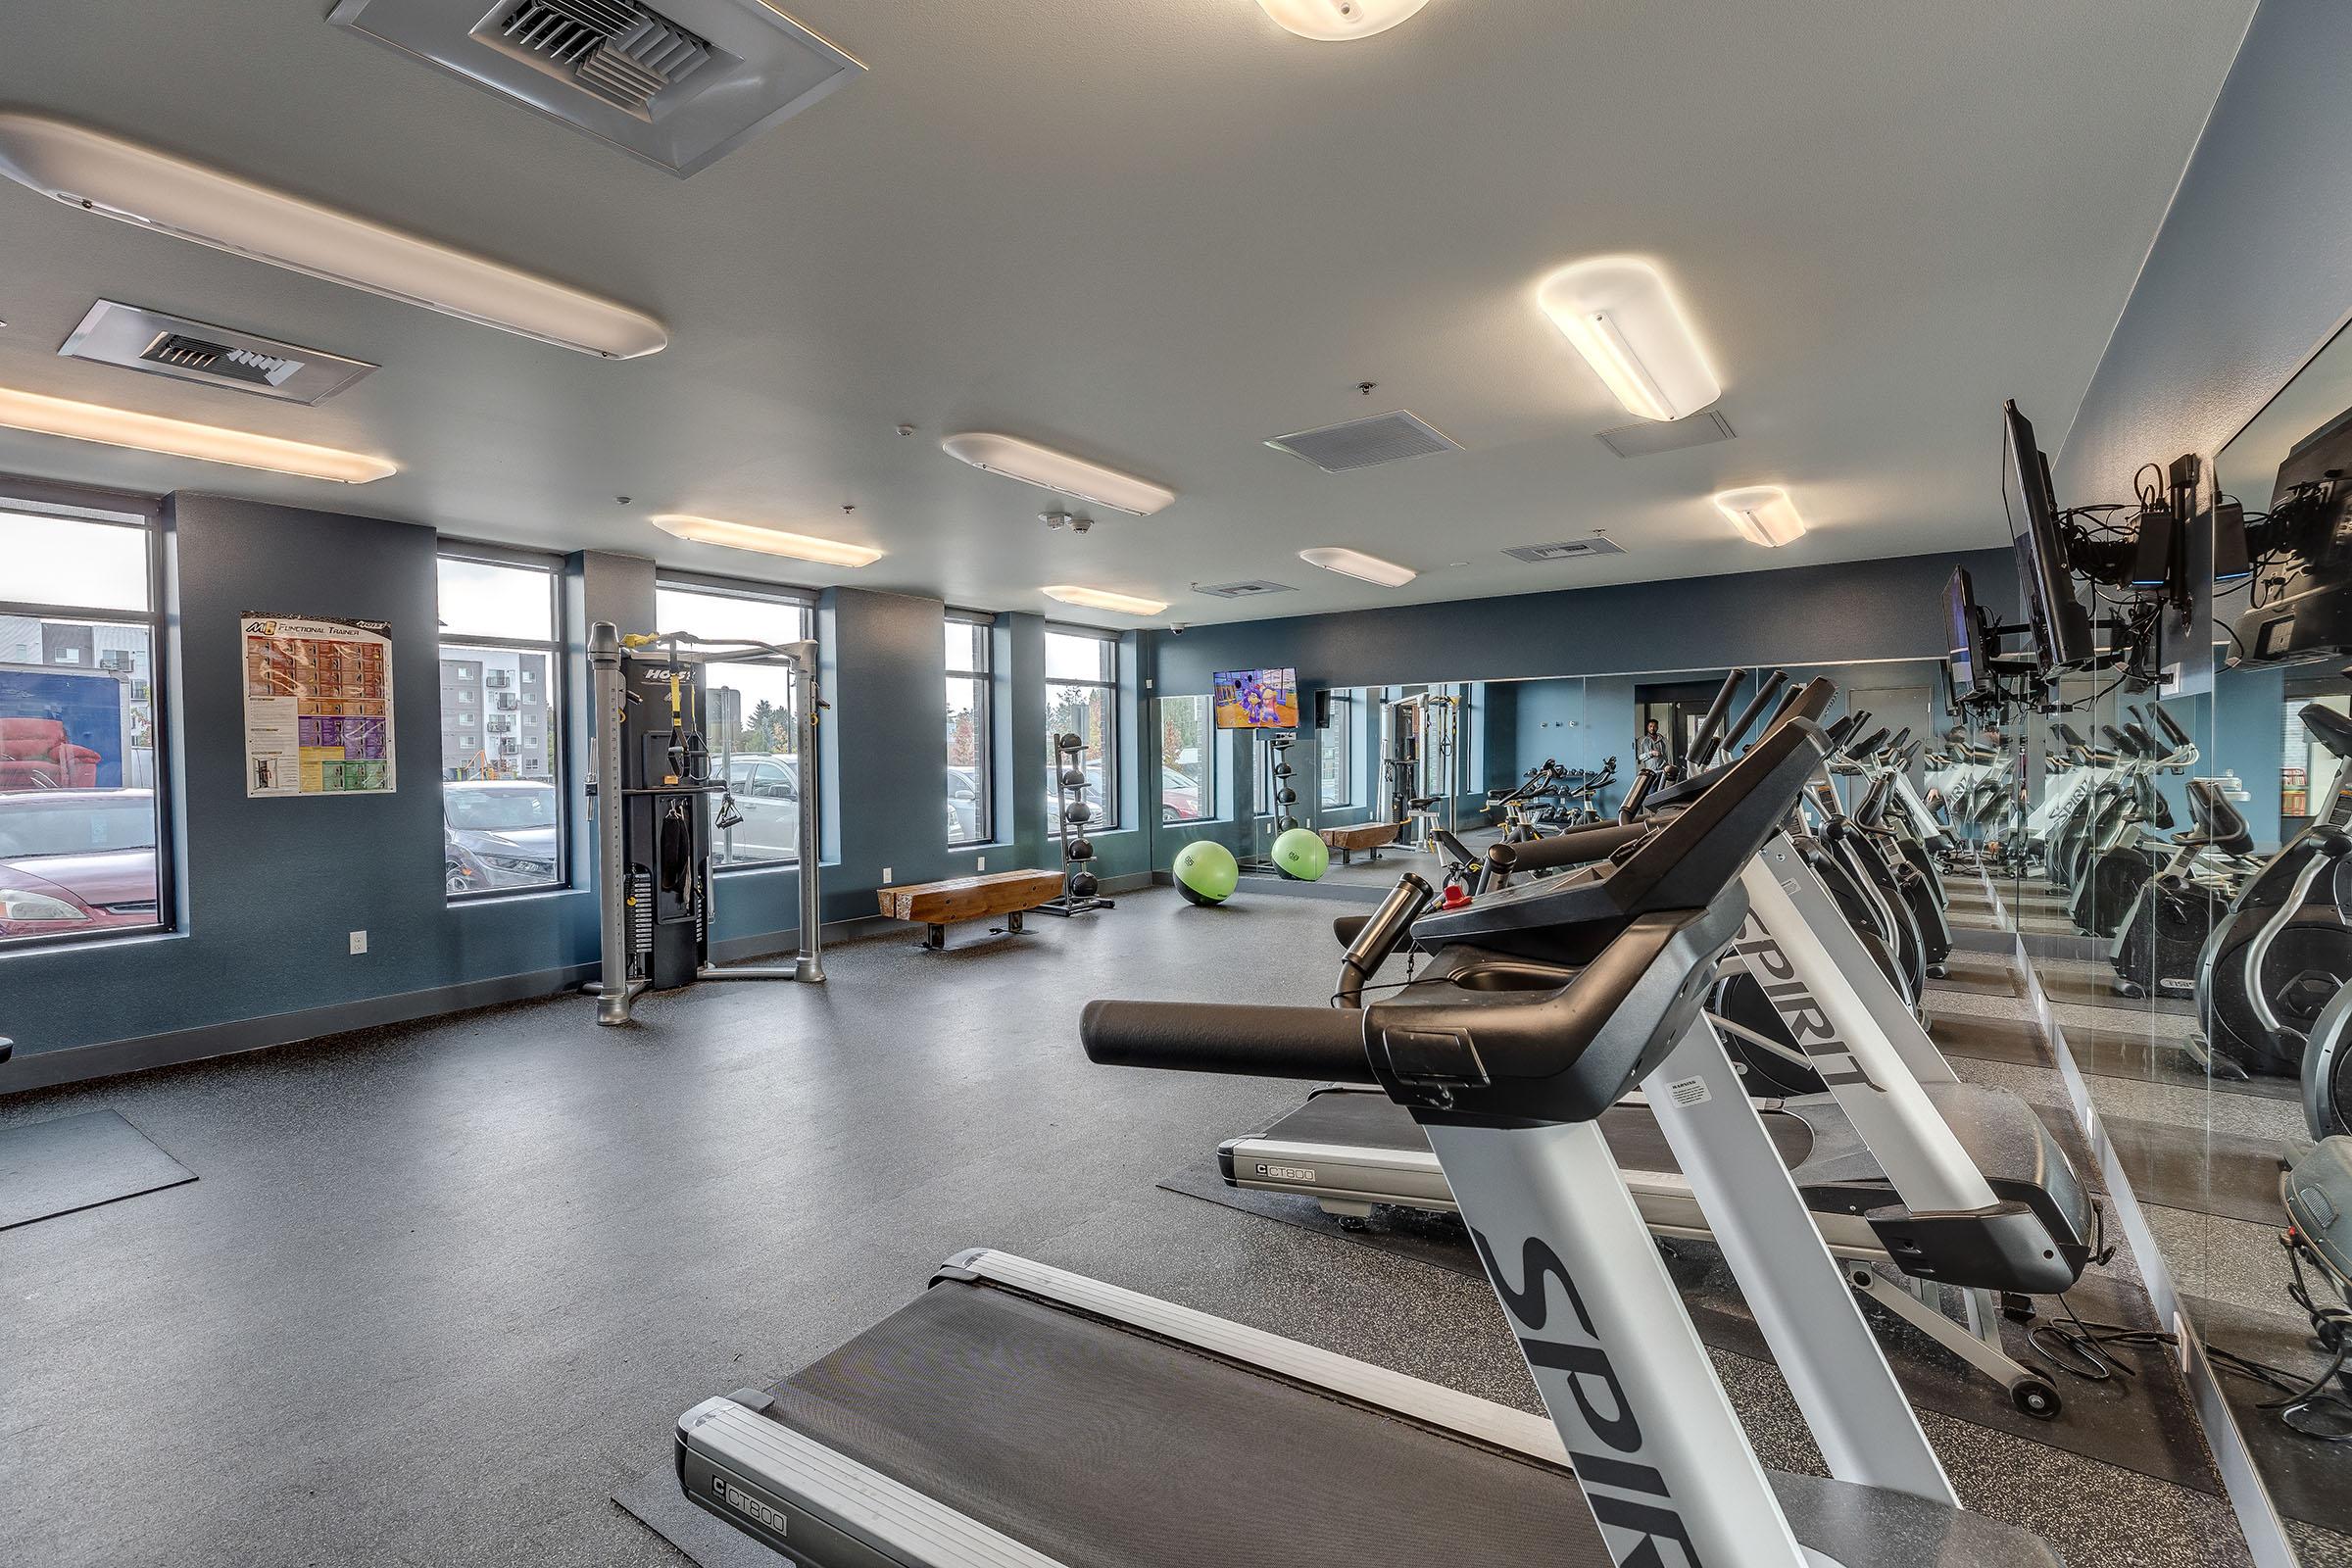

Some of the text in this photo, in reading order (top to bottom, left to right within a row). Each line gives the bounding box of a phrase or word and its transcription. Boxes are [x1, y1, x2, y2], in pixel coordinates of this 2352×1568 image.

[328, 627, 360, 636] TRAINER
[645, 669, 696, 679] HOST
[1269, 1166, 1314, 1180] CT800
[728, 1488, 784, 1533] CT800
